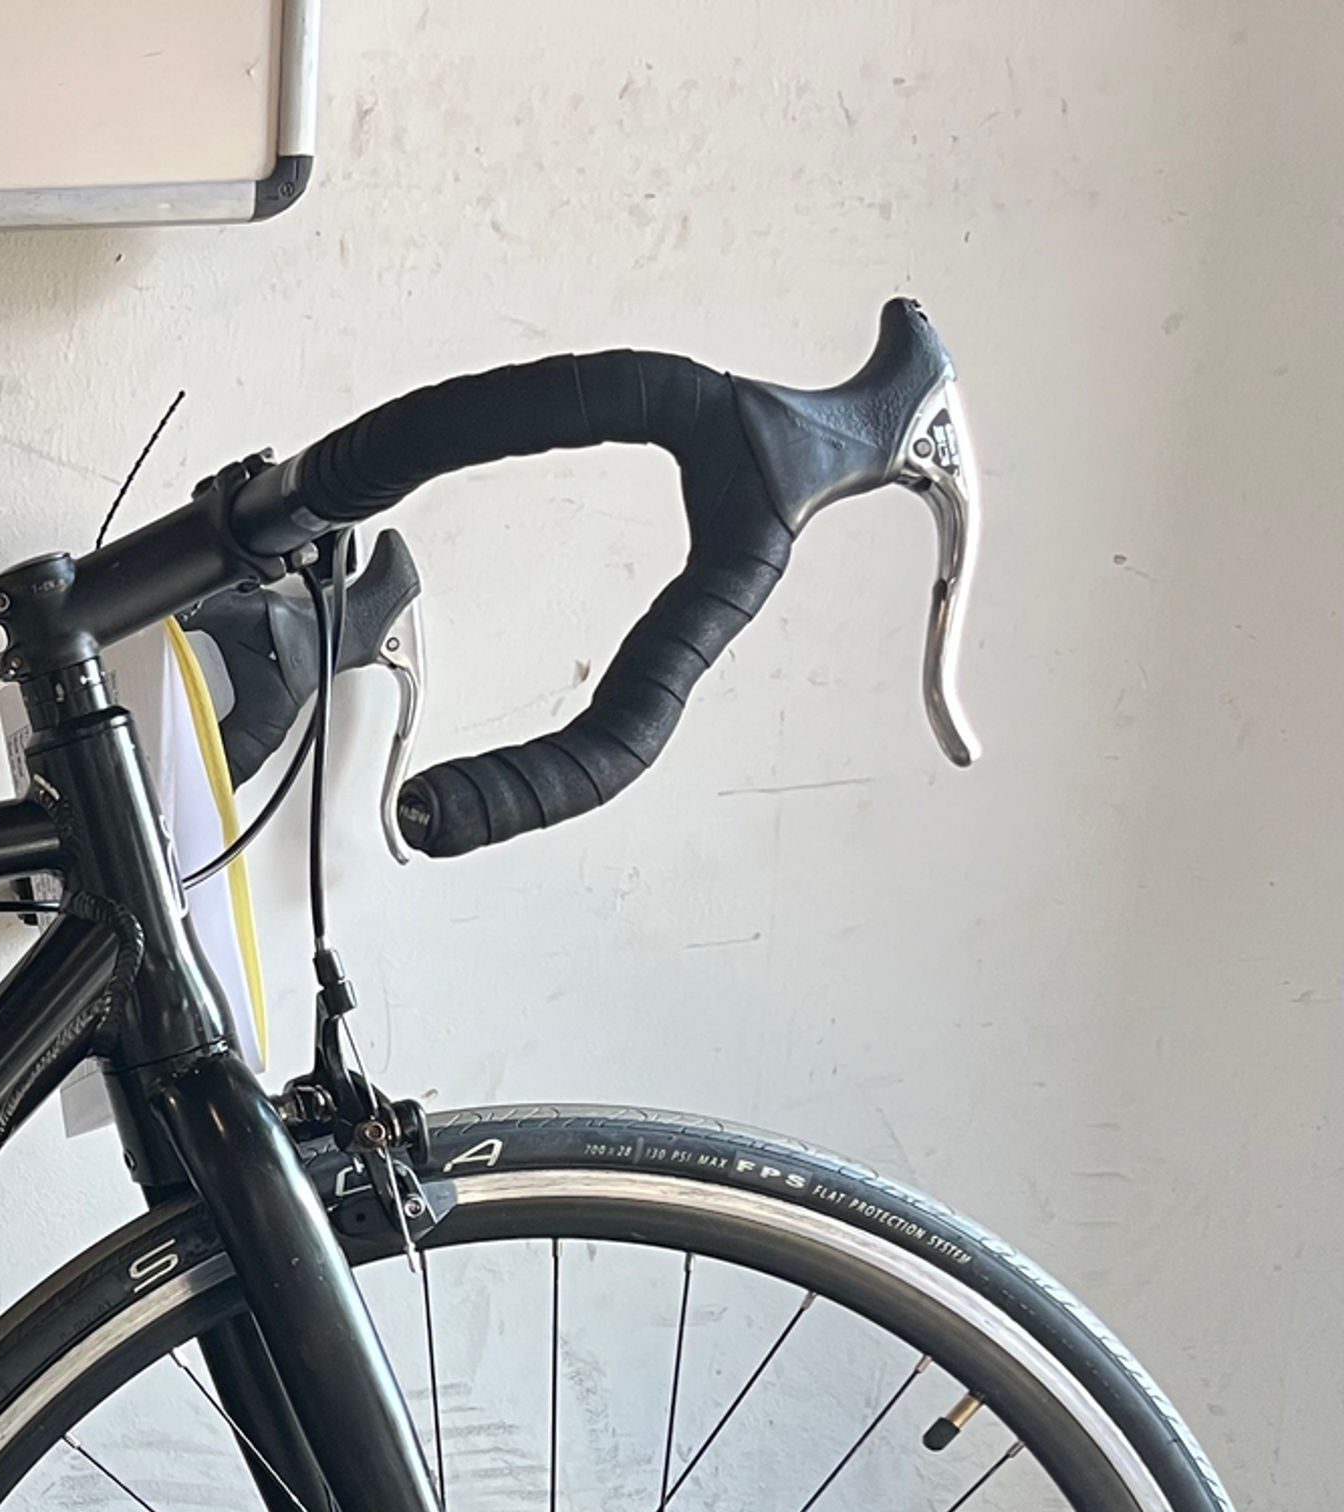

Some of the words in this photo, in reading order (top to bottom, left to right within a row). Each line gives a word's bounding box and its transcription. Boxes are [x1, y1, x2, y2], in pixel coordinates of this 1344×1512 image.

[670, 1150, 693, 1164] PSI
[696, 1153, 729, 1170] MAX
[735, 1158, 806, 1190] FPS
[812, 1183, 844, 1205] FLAT
[847, 1198, 924, 1241] PROTECTION
[927, 1233, 974, 1266] SYSTEM
